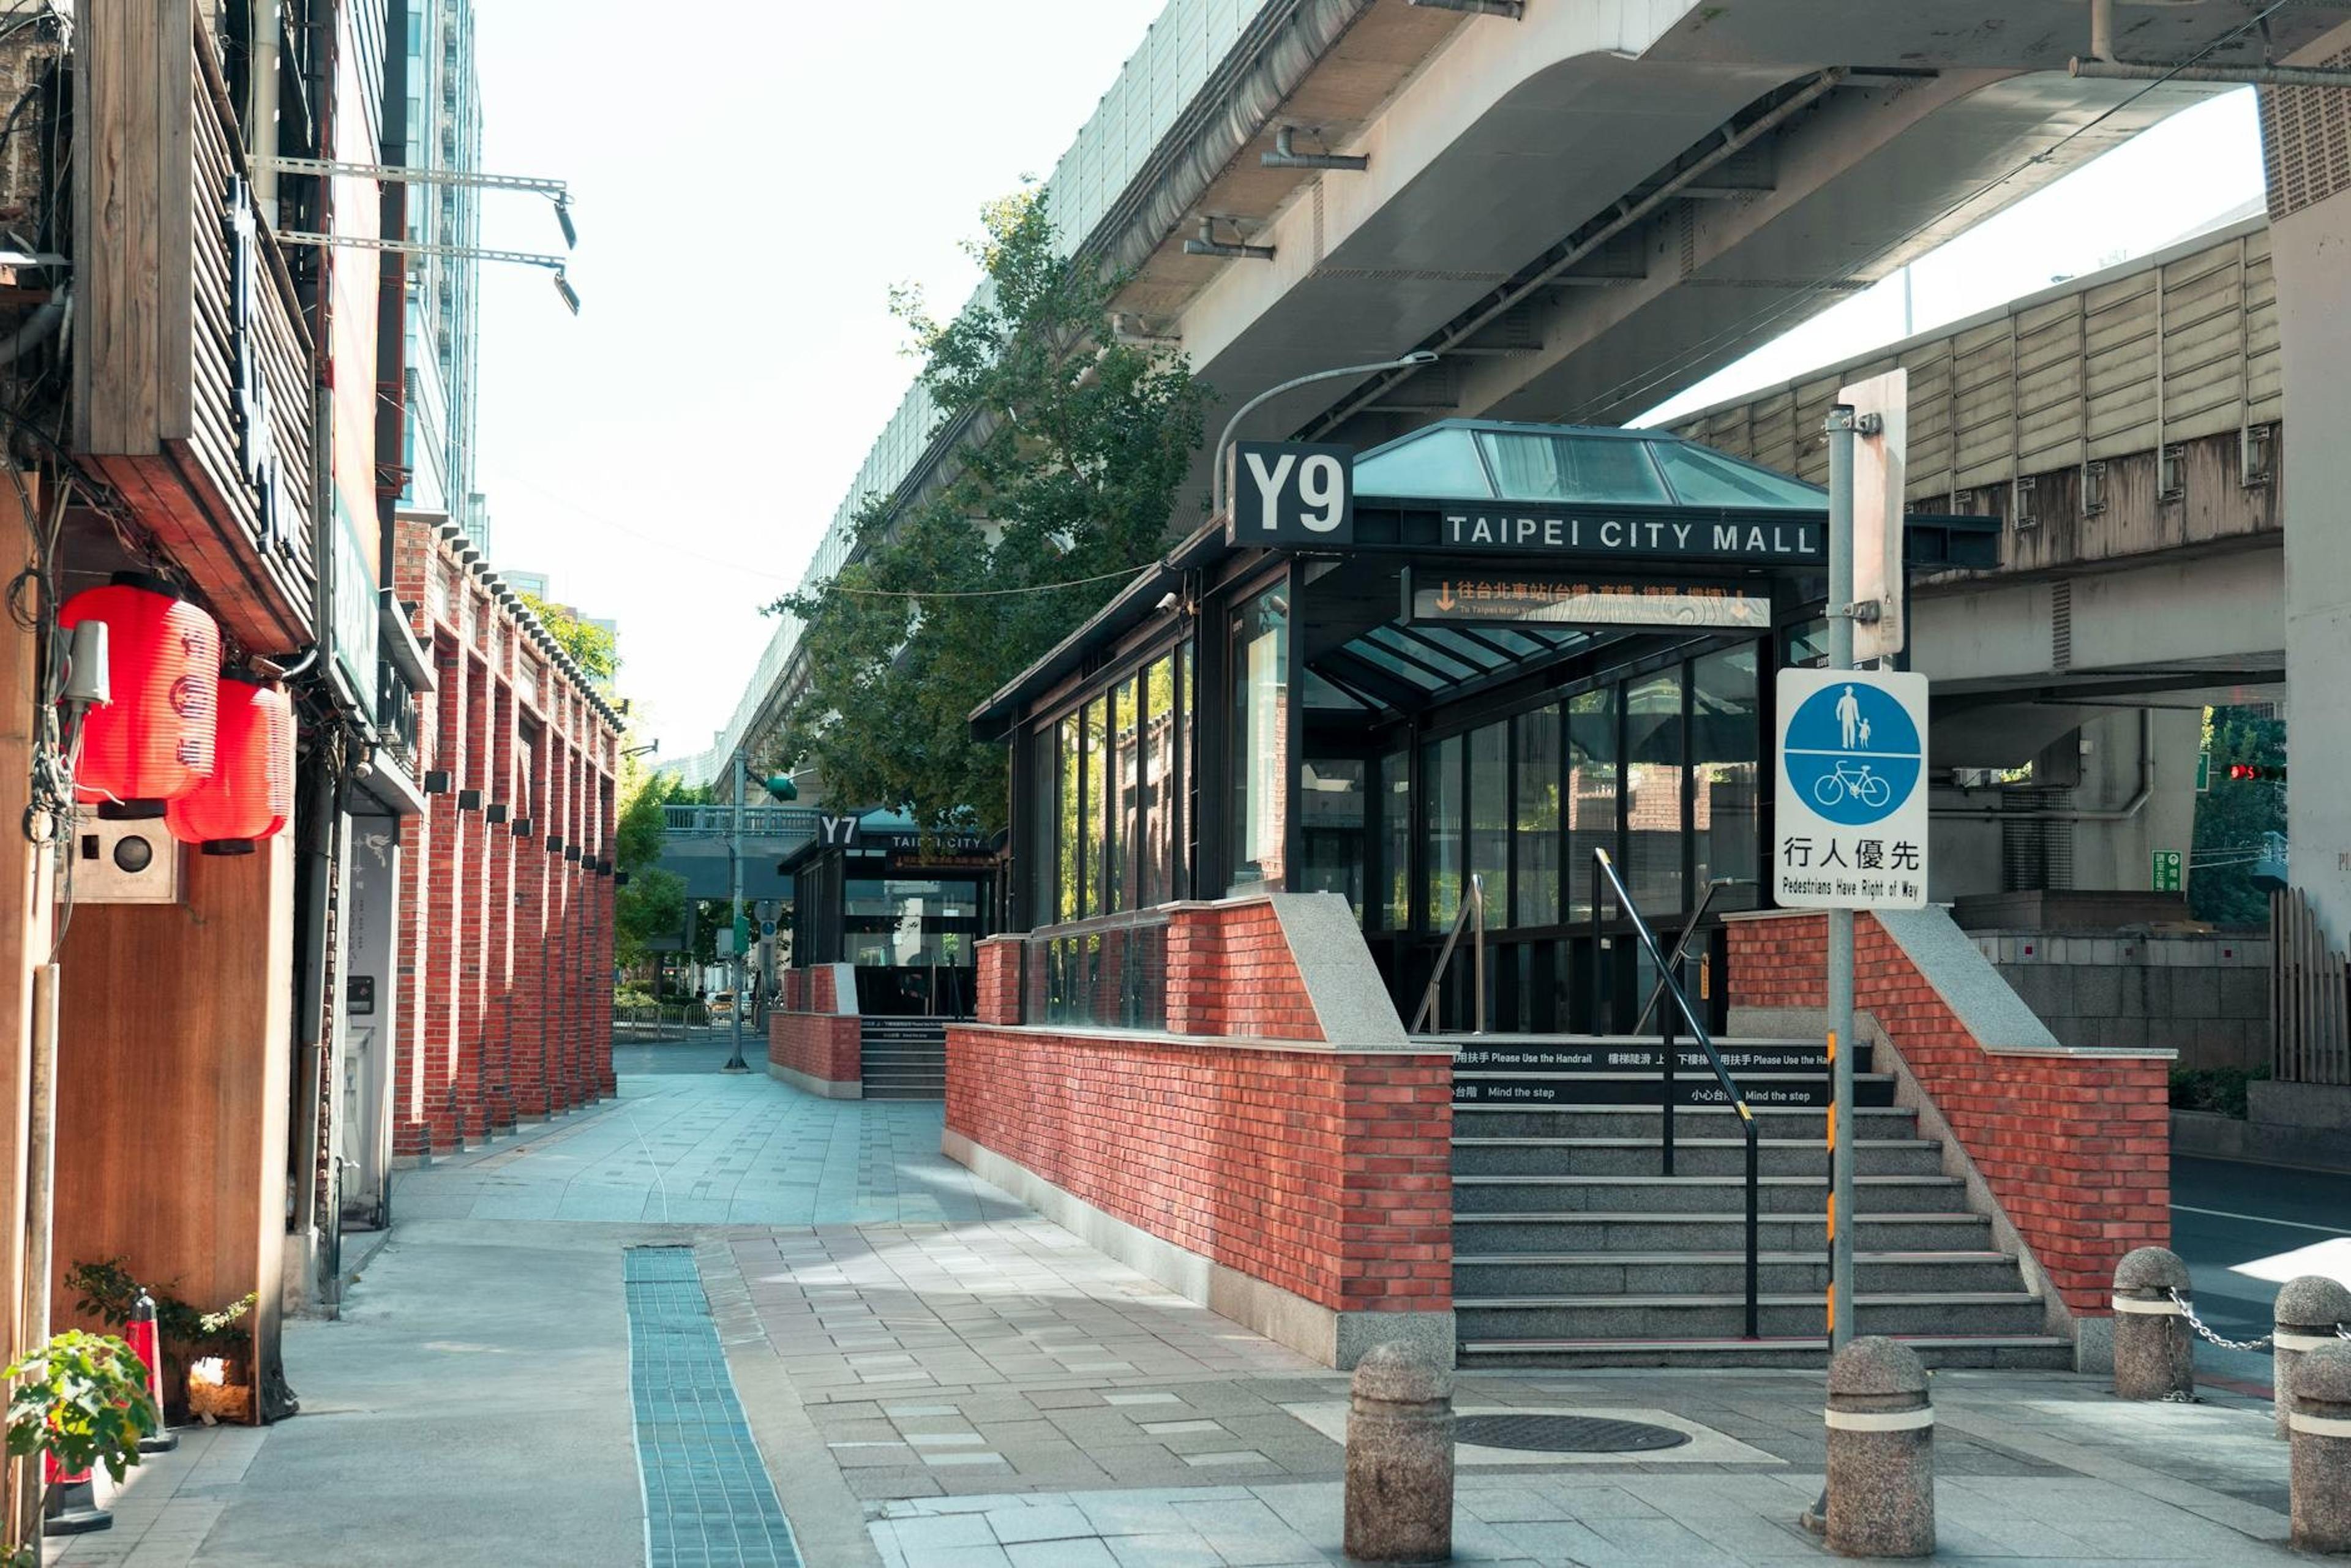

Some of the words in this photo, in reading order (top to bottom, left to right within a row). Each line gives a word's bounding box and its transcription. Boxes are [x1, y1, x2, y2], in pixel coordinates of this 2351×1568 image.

[1243, 452, 1344, 532] Y9
[1446, 517, 1578, 546] TAIPEI
[1600, 521, 1692, 549] CITY
[1713, 525, 1816, 553] MALL
[822, 816, 857, 844] Y7
[893, 836, 941, 847] TAII
[947, 838, 981, 849] CITY
[1784, 837, 1919, 870] 行人優先
[1783, 877, 1832, 895] Pedestrians
[1837, 878, 1856, 896] Have
[1862, 880, 1883, 901] Right
[1889, 880, 1897, 896] of
[1902, 880, 1919, 902] Way
[1453, 1052, 1489, 1063] 用扶手
[1491, 1053, 1520, 1063] Please
[1523, 1054, 1538, 1063] Use
[1540, 1054, 1554, 1063] the
[1556, 1054, 1592, 1063] Handrail
[1753, 1055, 1781, 1065] Please
[1783, 1056, 1799, 1065] Use
[1801, 1056, 1814, 1065] the
[1452, 1086, 1477, 1098] 台階
[1488, 1087, 1512, 1097] Mind
[1515, 1088, 1531, 1097] the
[1532, 1089, 1555, 1099] step
[1745, 1090, 1769, 1101] Mind
[1771, 1091, 1787, 1101] the
[1789, 1092, 1810, 1102] step
